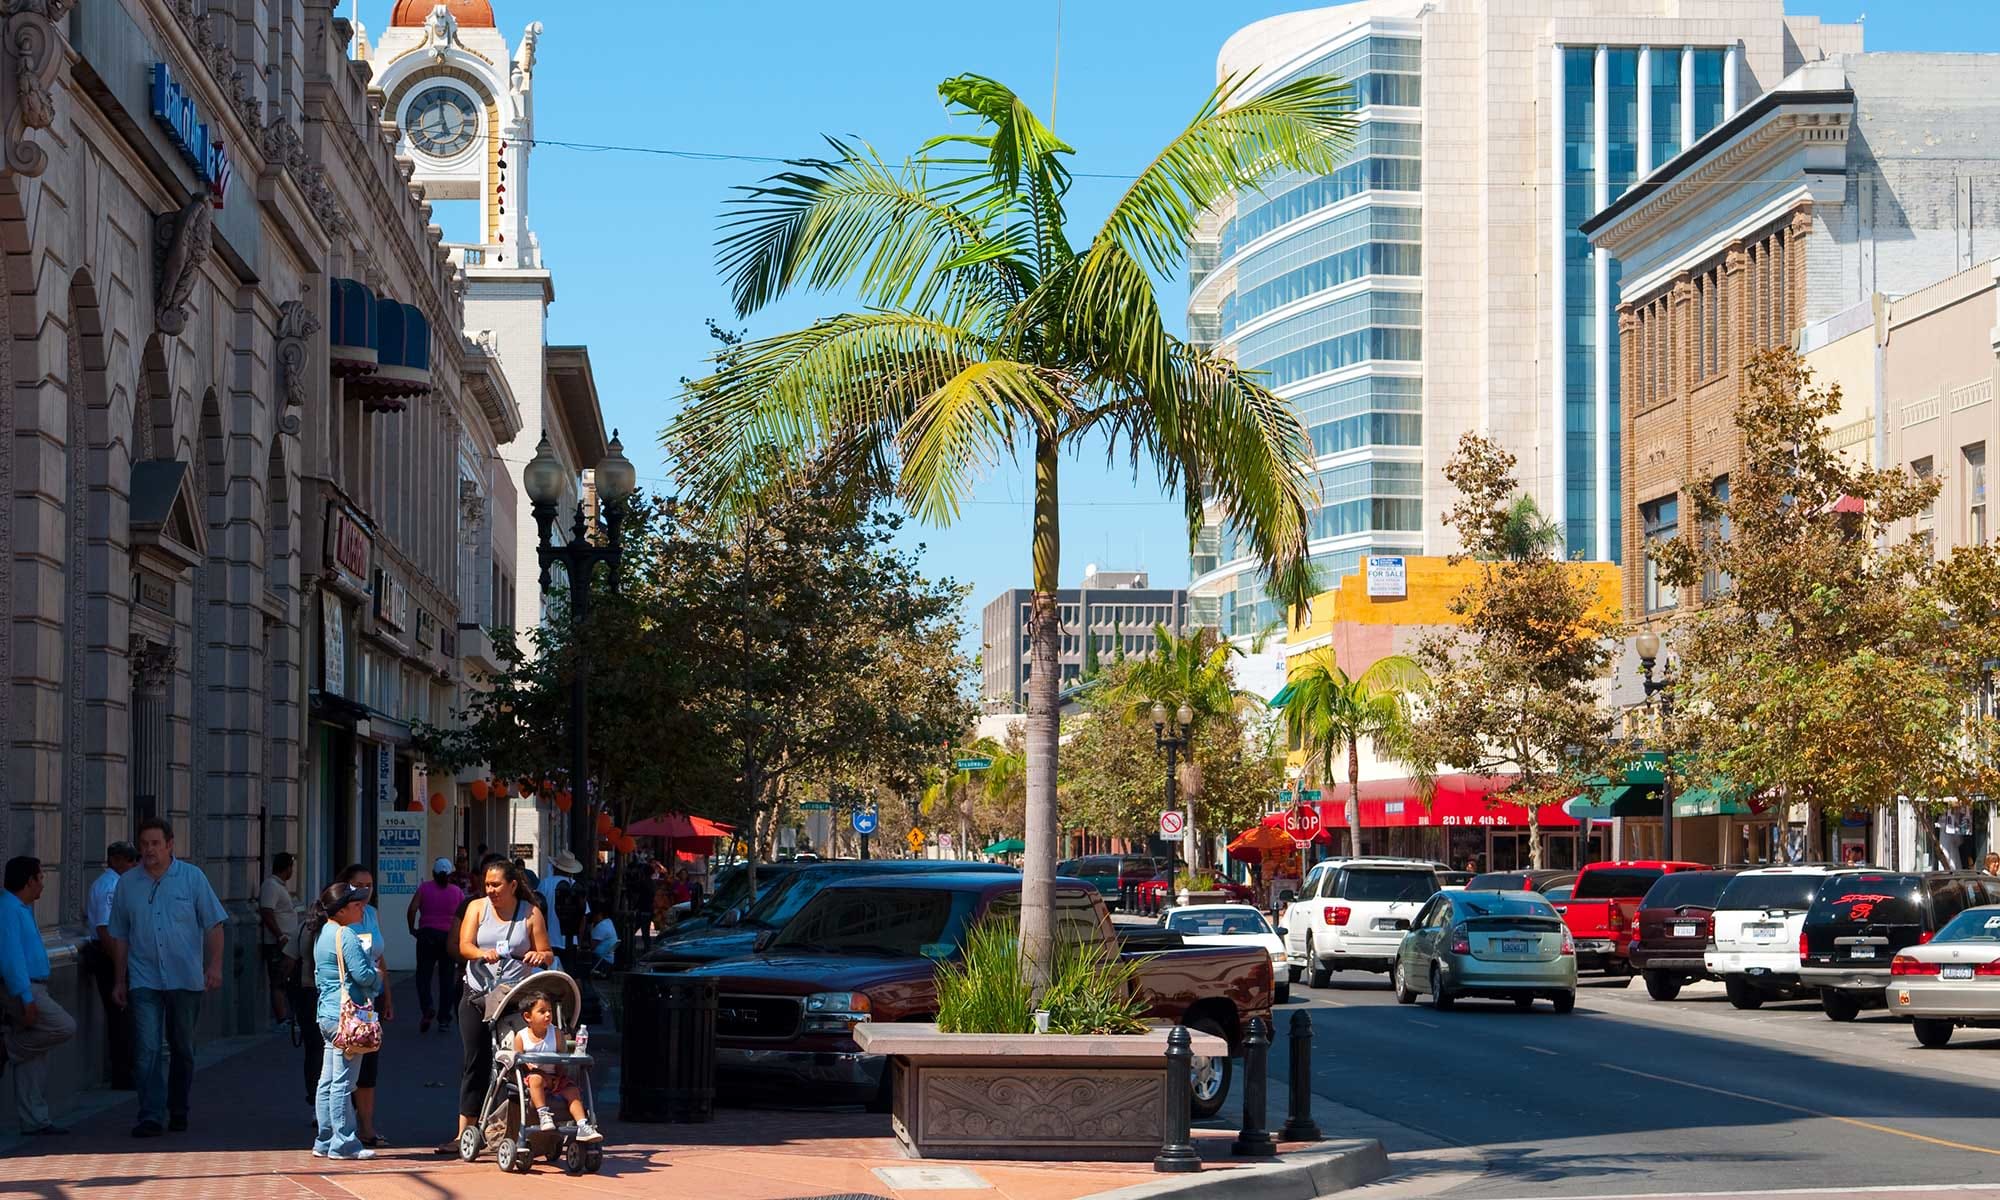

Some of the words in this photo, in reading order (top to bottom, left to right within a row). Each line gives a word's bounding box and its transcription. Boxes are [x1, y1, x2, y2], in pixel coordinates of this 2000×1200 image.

[1442, 815, 1460, 825] 201
[1463, 815, 1476, 825] W.
[1479, 815, 1495, 825] 4th
[1497, 816, 1510, 825] St.
[379, 830, 420, 841] APILLA
[379, 859, 417, 871] NCOME
[386, 872, 405, 884] TAX
